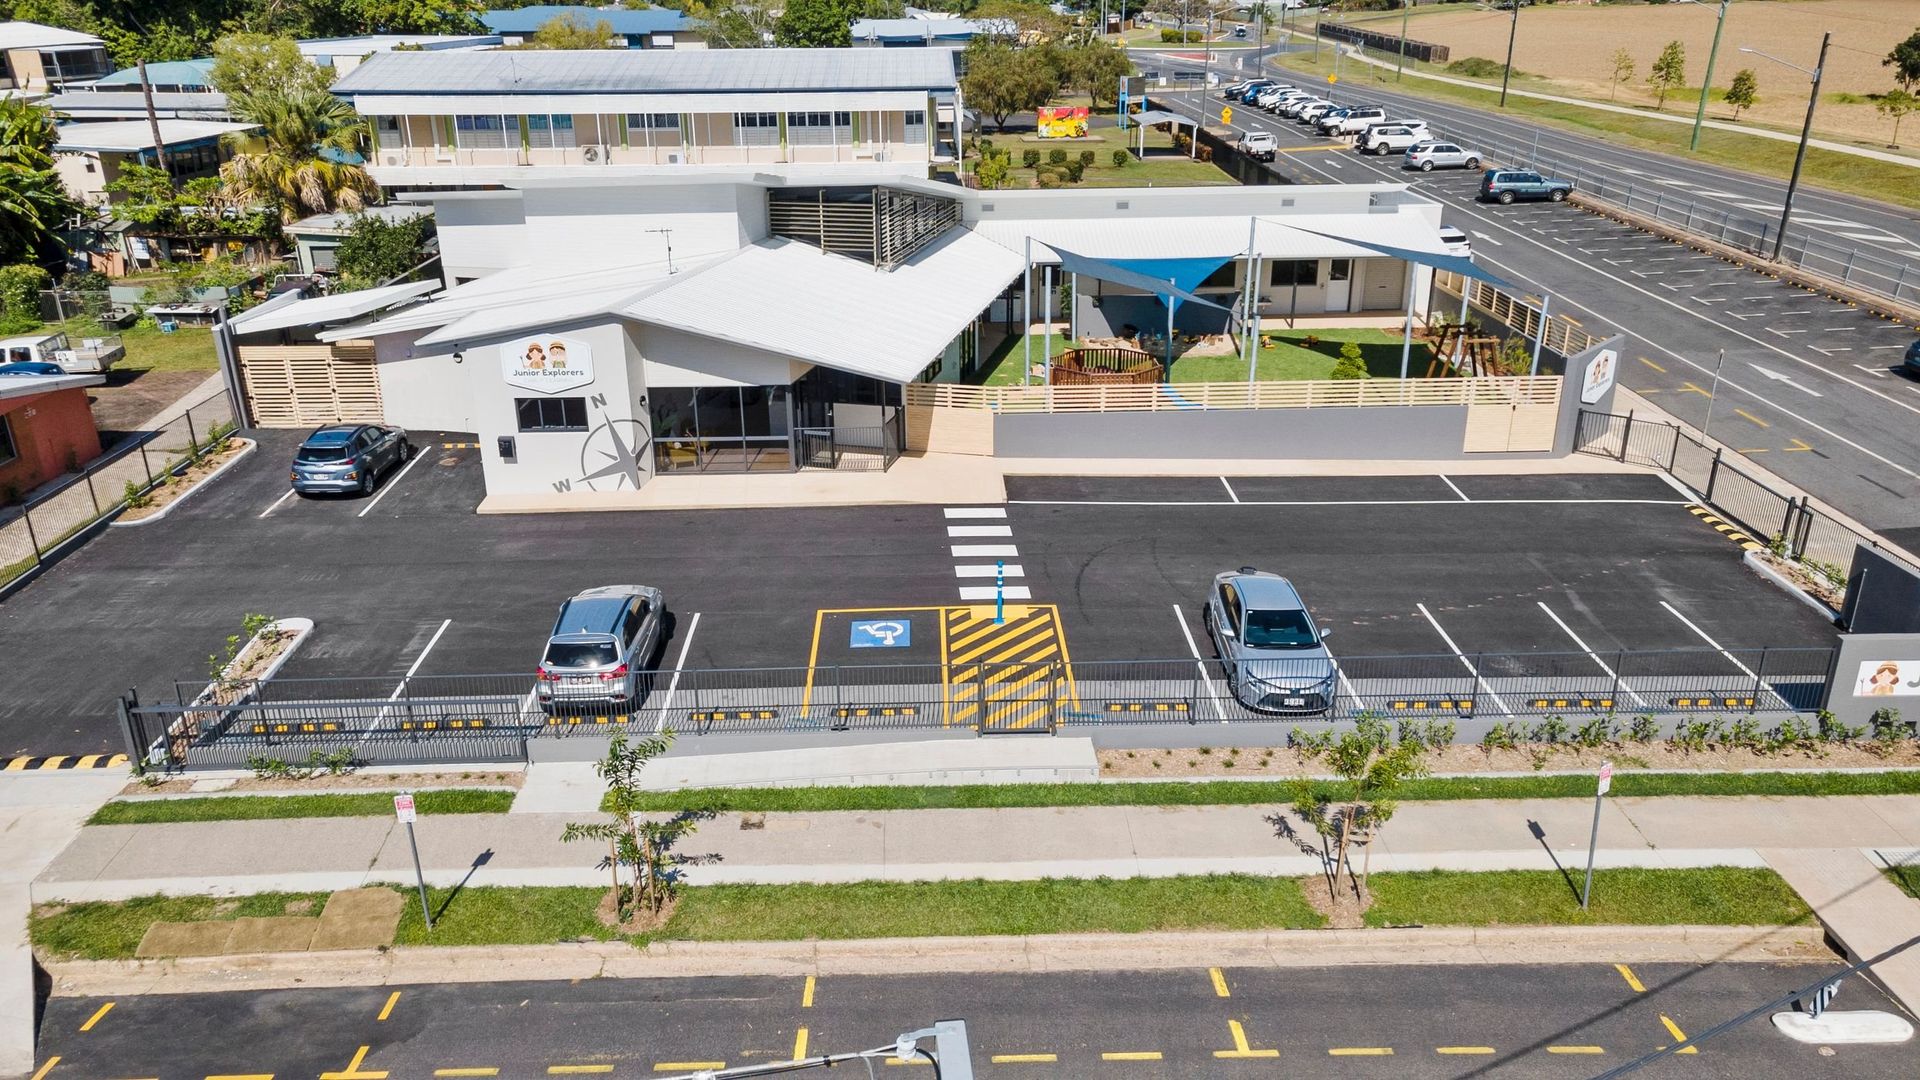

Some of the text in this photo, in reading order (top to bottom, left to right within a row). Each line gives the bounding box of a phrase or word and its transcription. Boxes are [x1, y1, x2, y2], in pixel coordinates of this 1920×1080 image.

[513, 369, 584, 378] Junior Explorers
[590, 392, 607, 409] N
[552, 478, 571, 494] W
